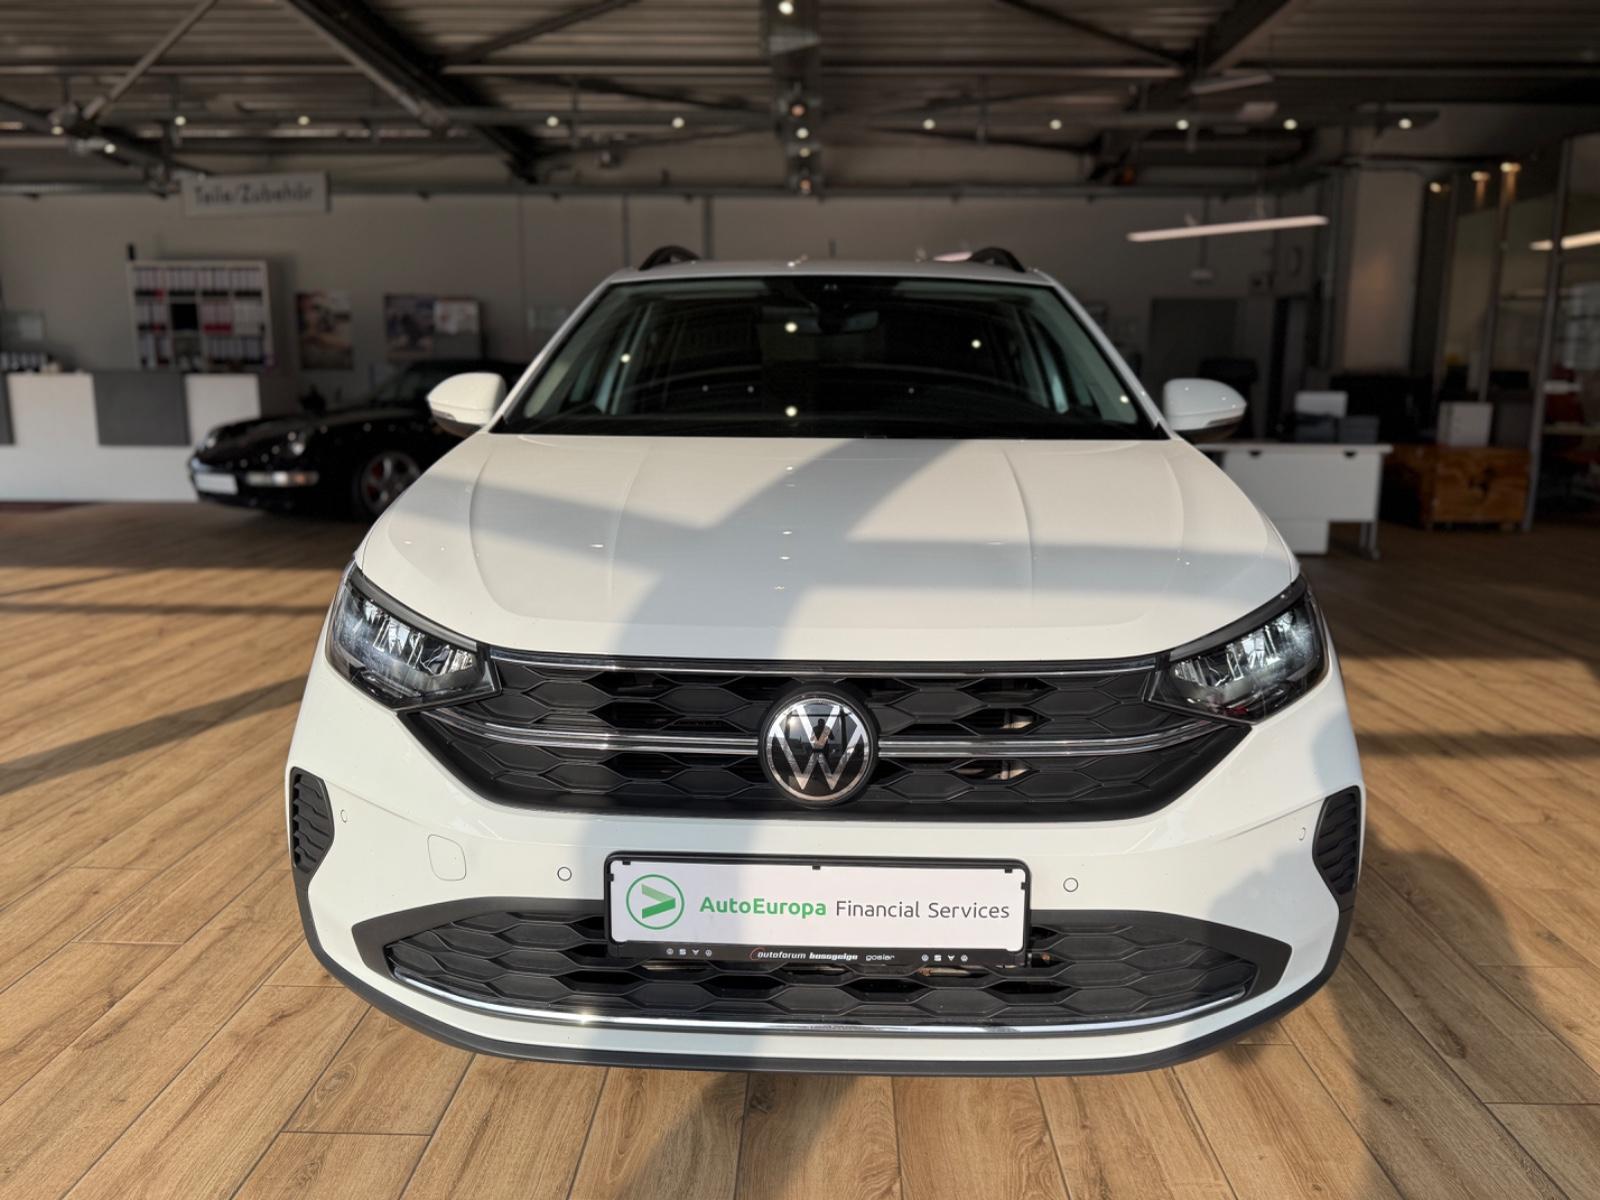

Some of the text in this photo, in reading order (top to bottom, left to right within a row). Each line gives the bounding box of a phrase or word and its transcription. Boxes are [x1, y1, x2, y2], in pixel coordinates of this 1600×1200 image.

[699, 896, 1010, 919] AutoEuropa Financial Services
[757, 951, 806, 960] autoforum
[865, 953, 895, 962] goslar
